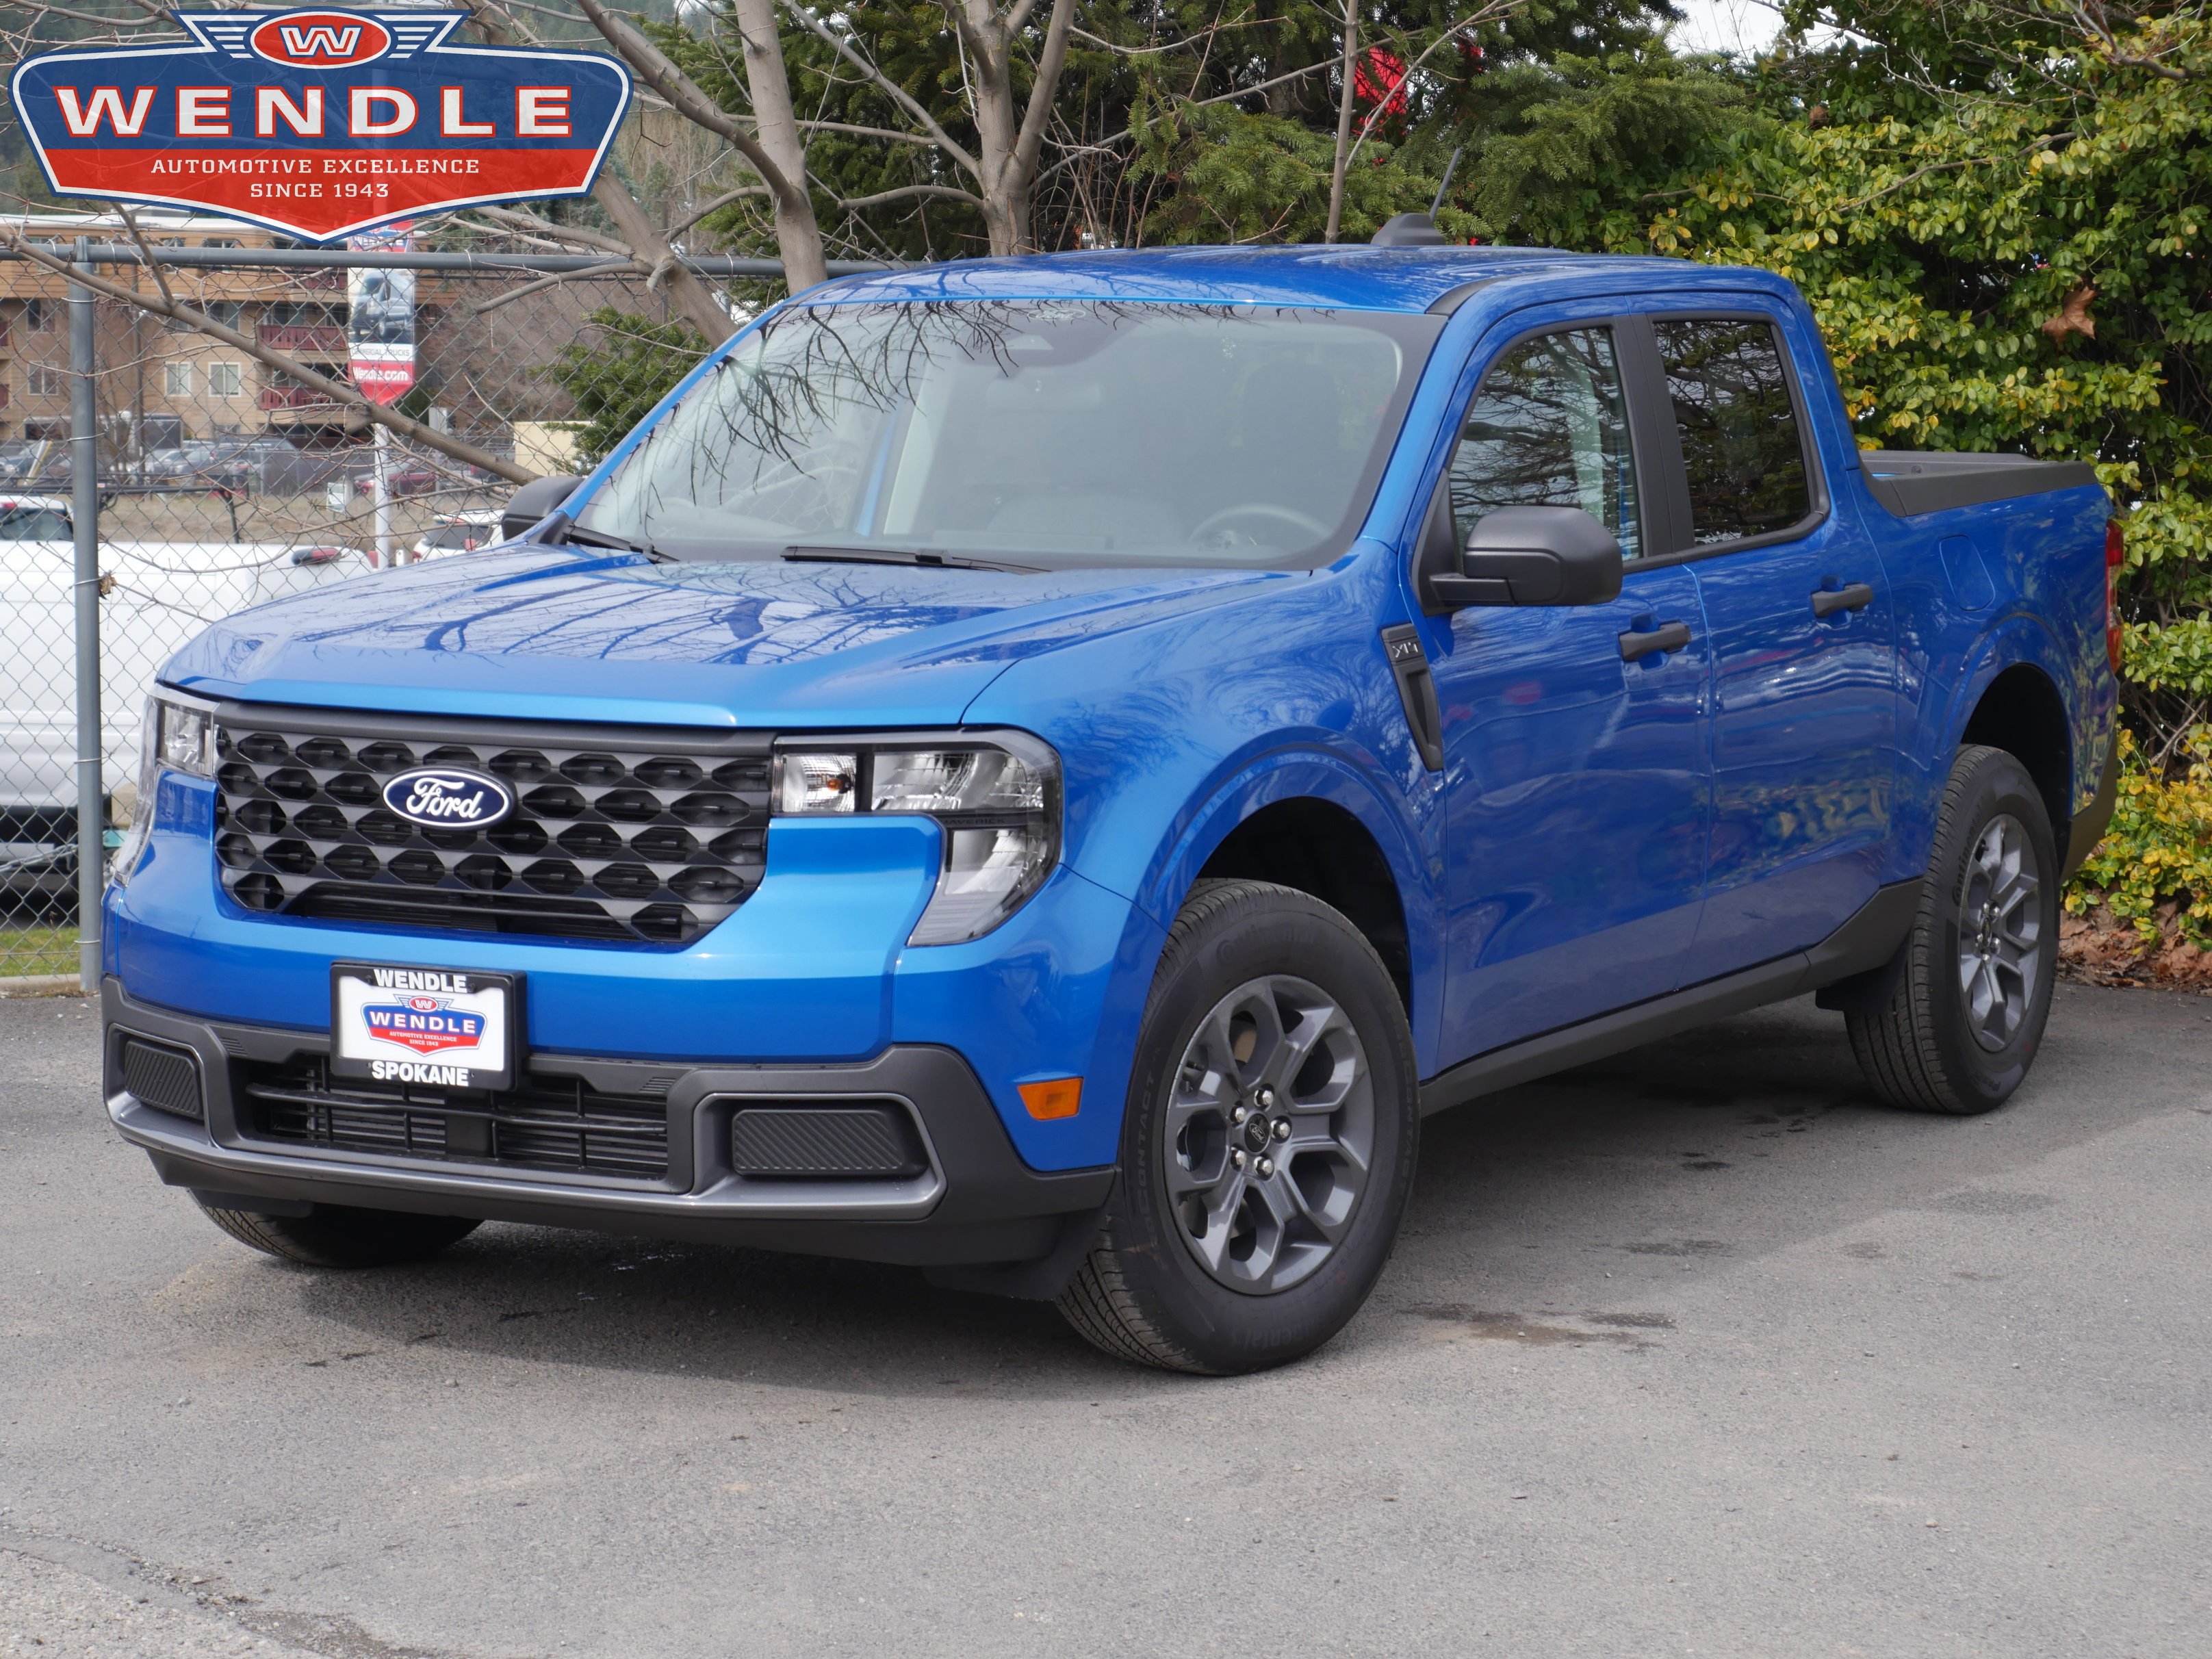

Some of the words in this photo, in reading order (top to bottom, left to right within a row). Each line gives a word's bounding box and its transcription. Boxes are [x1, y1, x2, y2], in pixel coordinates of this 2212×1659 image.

[352, 366, 409, 381] Wendle.com
[406, 777, 484, 819] Ford
[374, 968, 468, 993] WENDLE
[370, 1011, 476, 1034] WENDLE
[389, 1031, 423, 1039] AUTOMOTIVE
[424, 1034, 457, 1042] EXCELLENCE
[372, 1060, 470, 1087] SPOKANE
